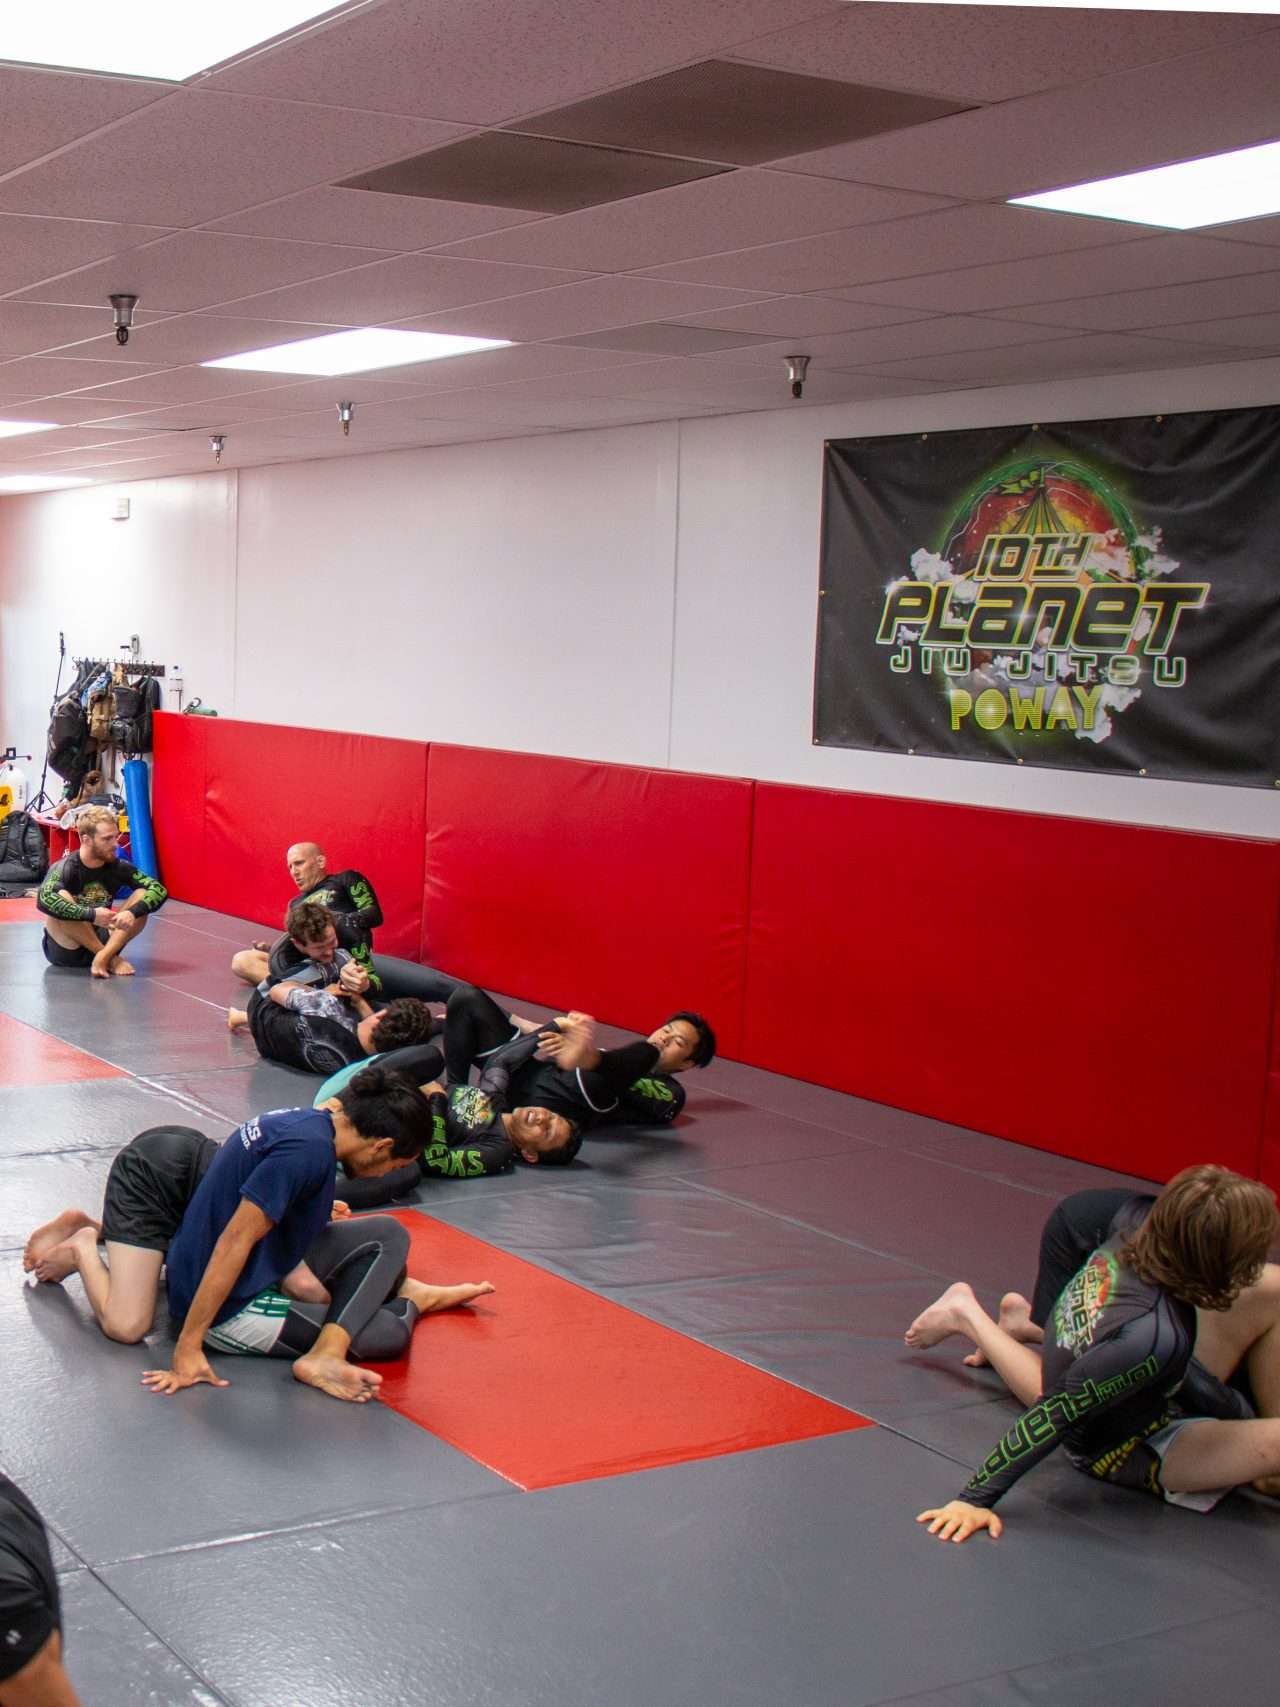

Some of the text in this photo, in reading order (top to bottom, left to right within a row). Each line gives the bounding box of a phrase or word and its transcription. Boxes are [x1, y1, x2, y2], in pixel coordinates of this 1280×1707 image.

[890, 646, 1186, 688] JIU JITSU
[950, 684, 1105, 731] POWAY
